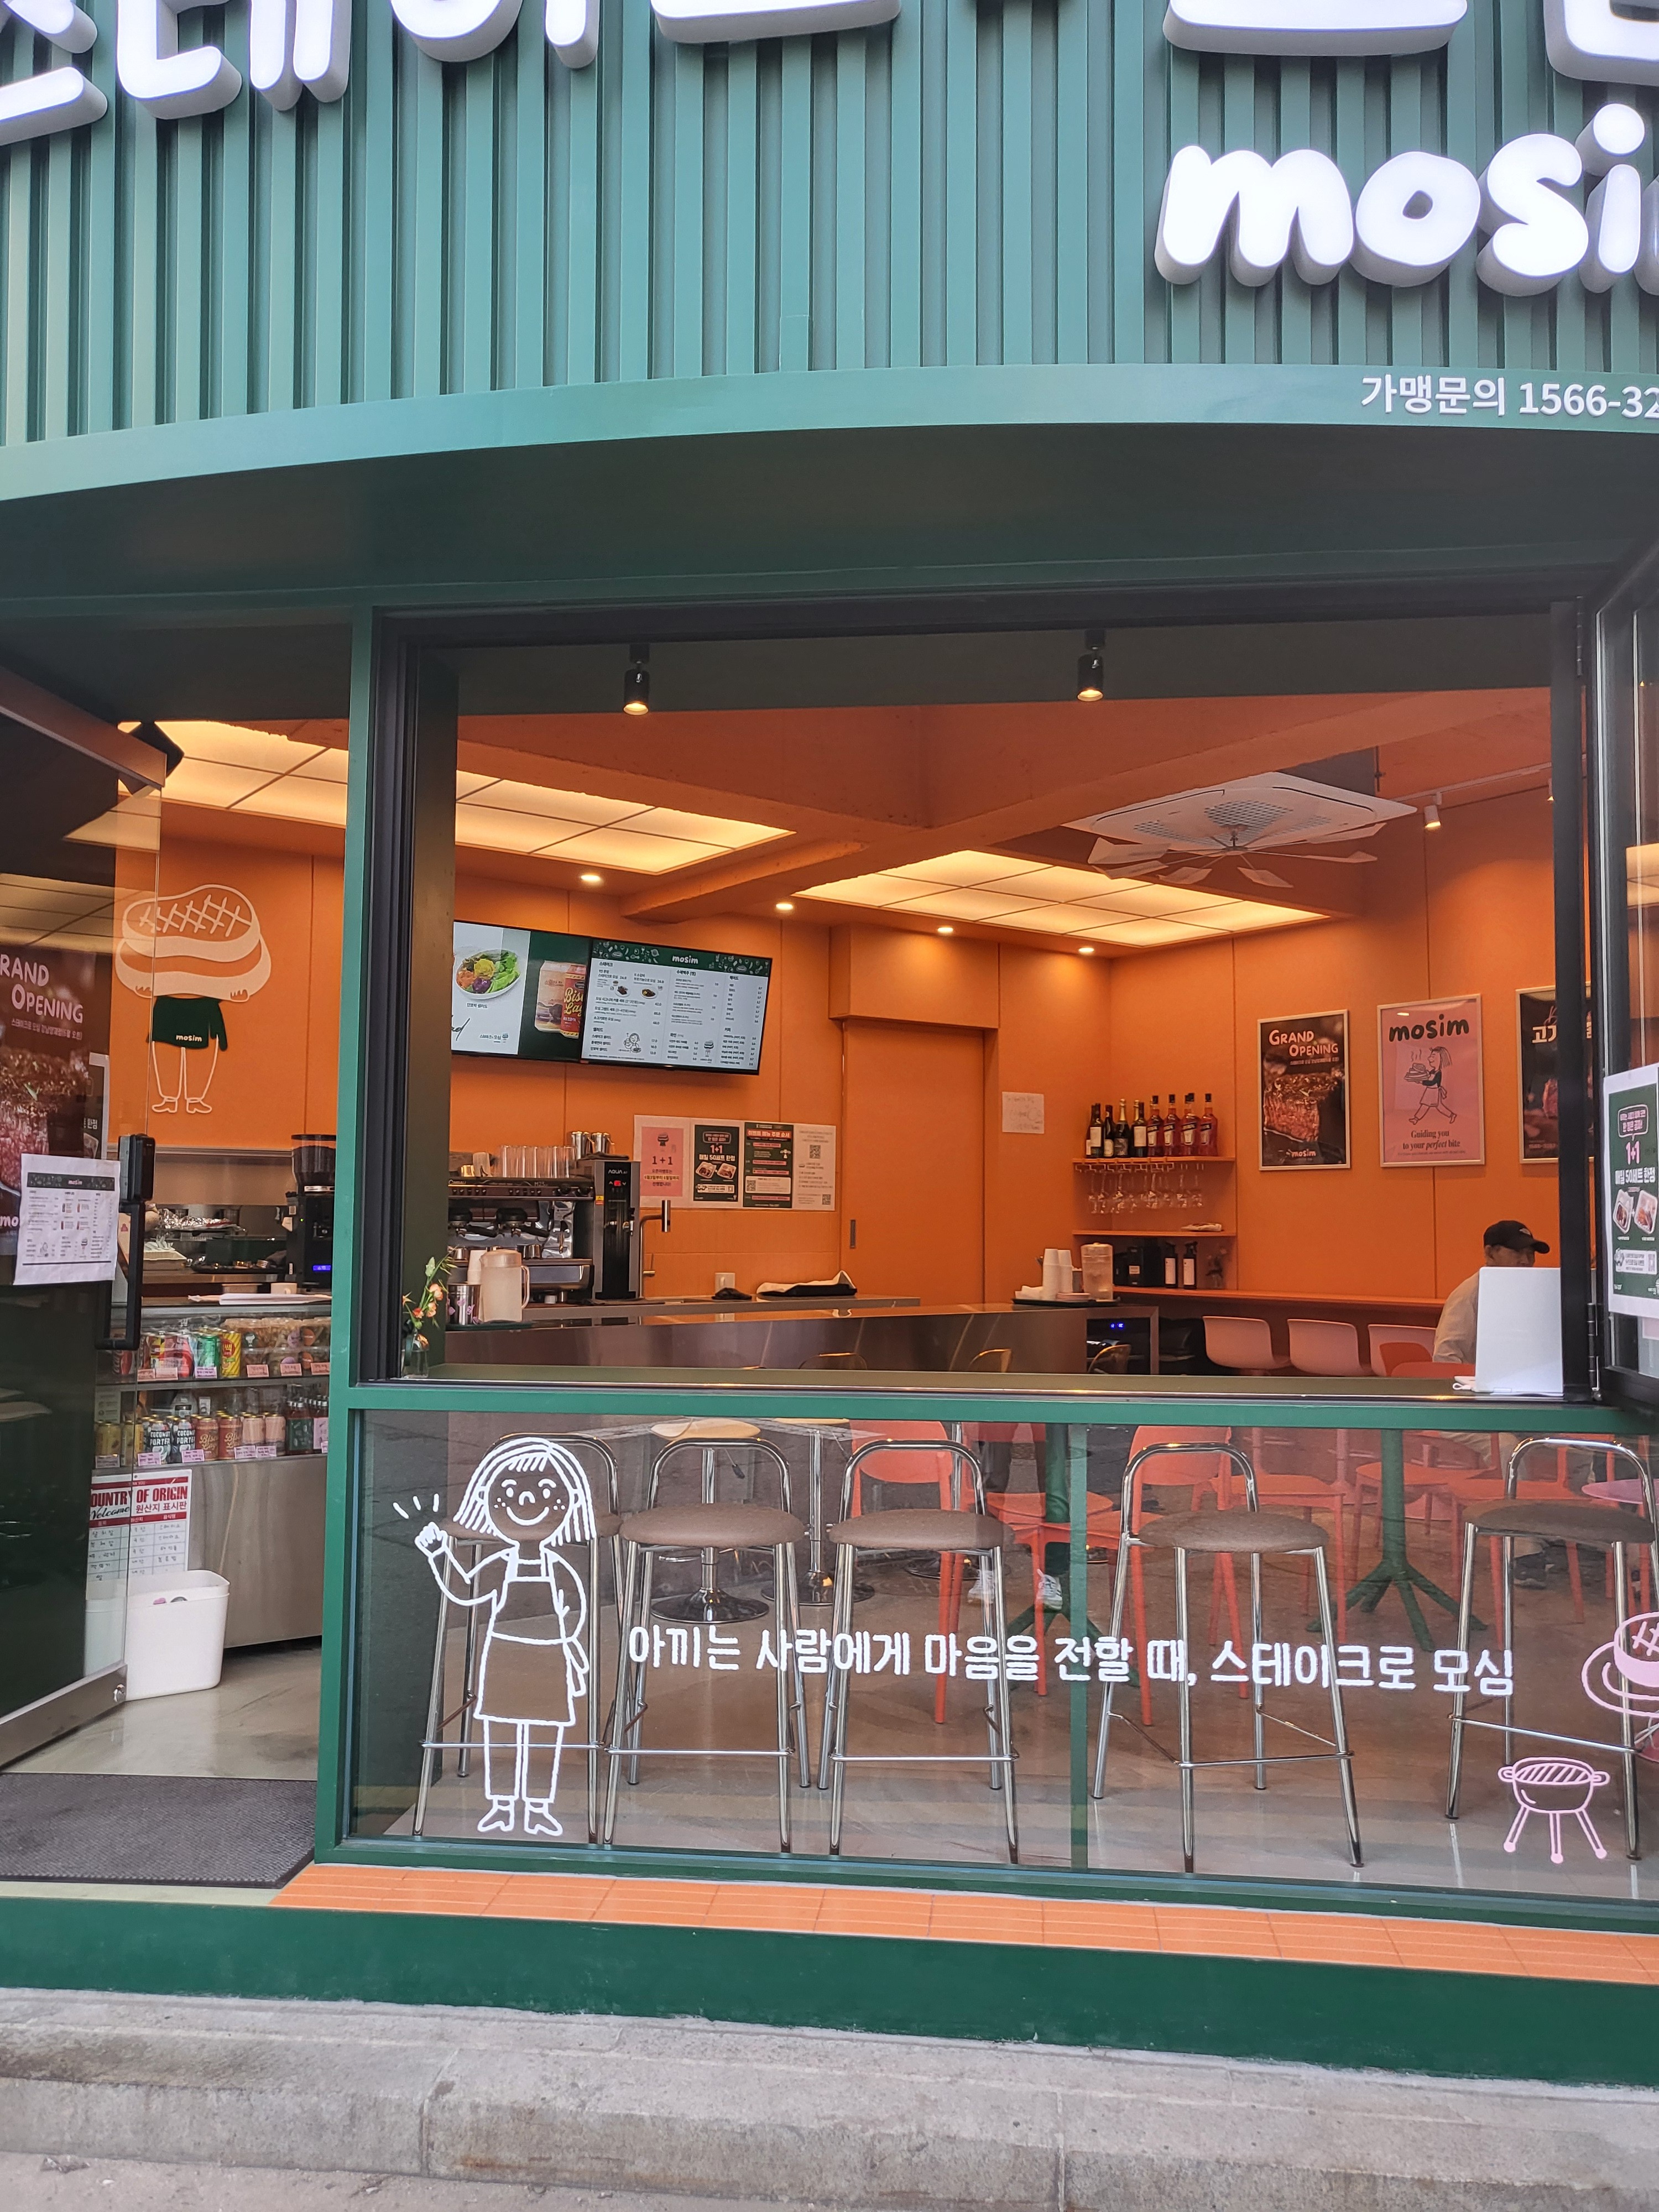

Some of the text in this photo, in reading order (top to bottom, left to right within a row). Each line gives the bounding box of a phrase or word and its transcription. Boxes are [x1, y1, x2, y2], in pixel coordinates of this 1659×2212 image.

[1155, 103, 1659, 296] mosi
[1361, 373, 1505, 416] 가맹문의
[672, 955, 698, 964] mosim
[0, 954, 49, 987] RAND
[564, 987, 583, 1003] Bis
[11, 984, 84, 1023] OPENING
[1389, 1014, 1469, 1042] mosim
[1269, 1030, 1314, 1046] GRAND
[1289, 1044, 1338, 1057] OPENING
[1411, 1129, 1449, 1139] Guiding you
[710, 1145, 723, 1154] 1+1
[1292, 1149, 1316, 1157] mosim
[1410, 1142, 1425, 1151] your
[1426, 1140, 1447, 1151] perfect
[1448, 1139, 1460, 1147] bite
[91, 1486, 188, 1507] OUNTRY OF ORIGIN
[135, 1501, 187, 1514] 원산지 표시판
[629, 1624, 1514, 1696] 아끼는 사람에게 마음을 전할 때, 스테이크로 모심
